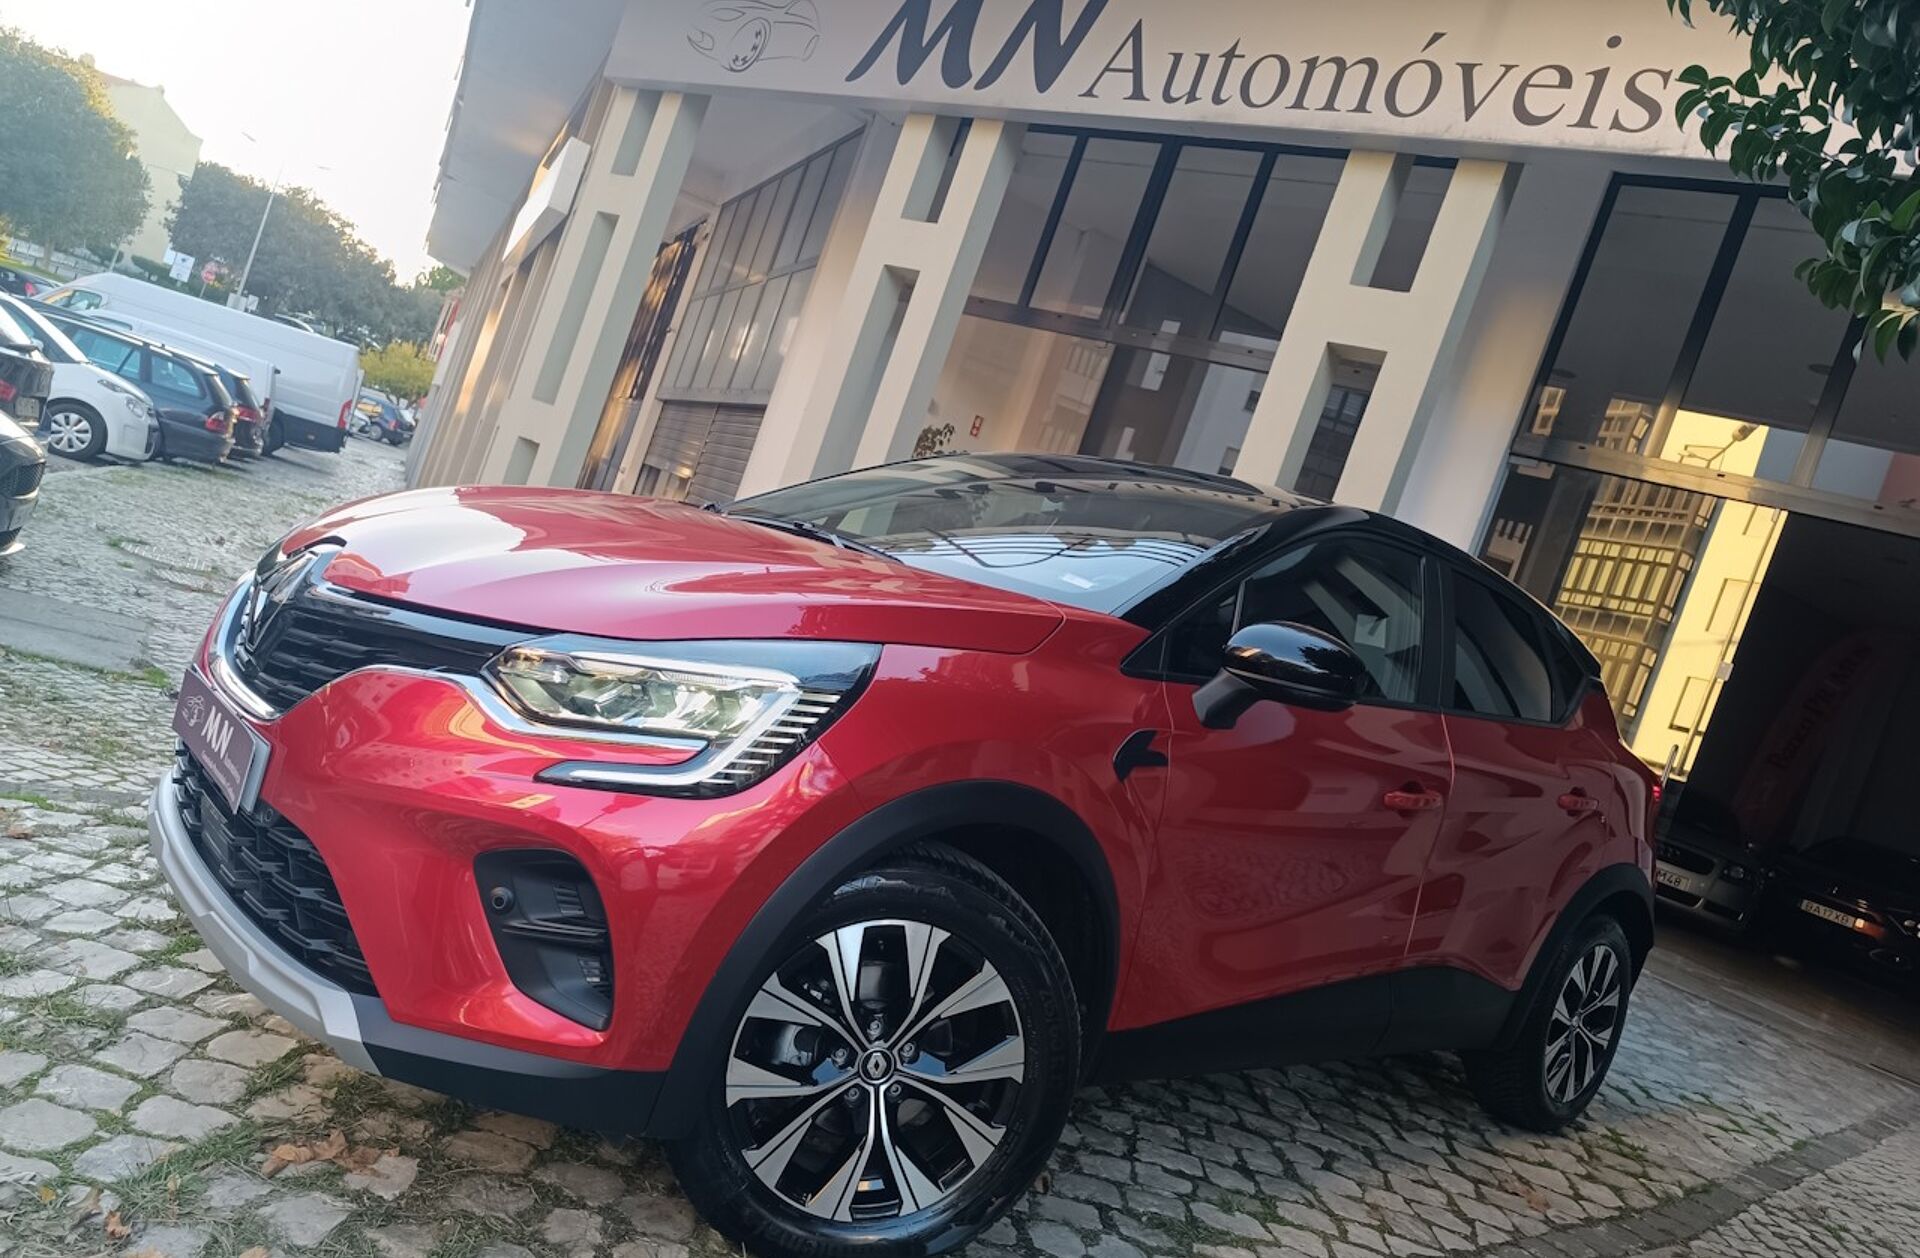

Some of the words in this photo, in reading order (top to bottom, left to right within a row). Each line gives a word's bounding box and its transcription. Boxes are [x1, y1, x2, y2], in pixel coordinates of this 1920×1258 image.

[844, 0, 1108, 94] MN
[1077, 18, 1673, 133] Automóveis
[201, 706, 234, 760] MN
